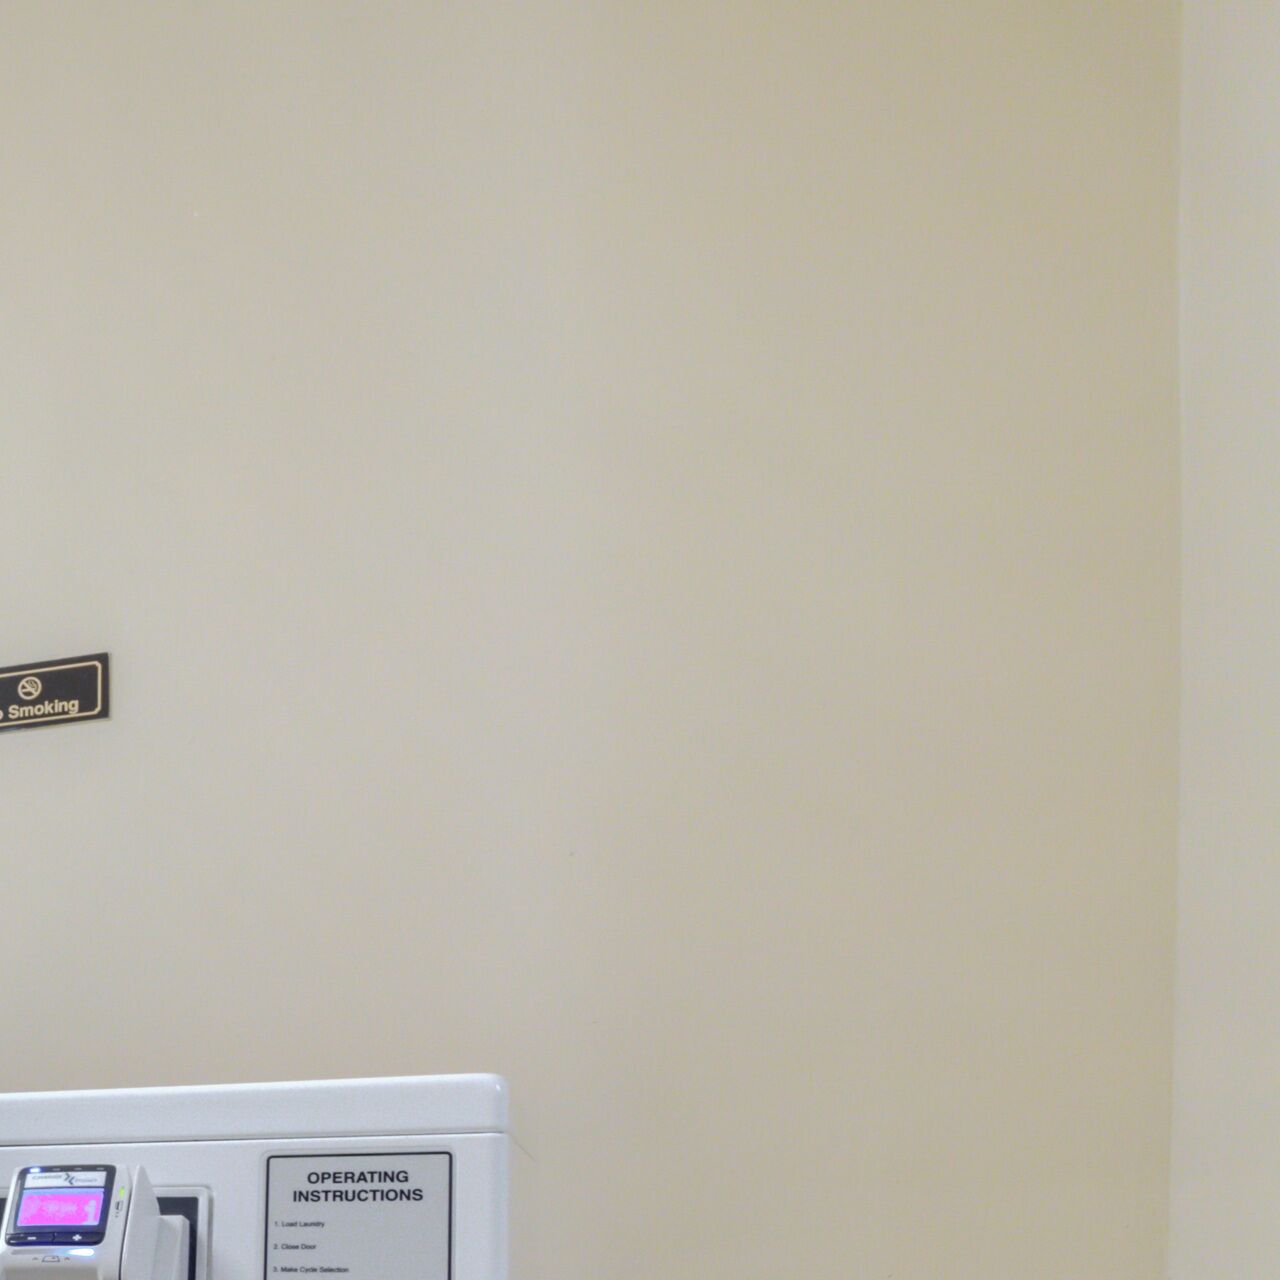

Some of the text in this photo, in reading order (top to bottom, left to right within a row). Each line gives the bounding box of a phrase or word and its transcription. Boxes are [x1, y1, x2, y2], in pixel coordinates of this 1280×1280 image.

[8, 699, 79, 719] Smoking
[307, 1170, 409, 1185] OPERATING
[293, 1188, 424, 1203] INSTRUCTIONS
[299, 1221, 325, 1229] Laundry
[299, 1266, 318, 1274] Cycle
